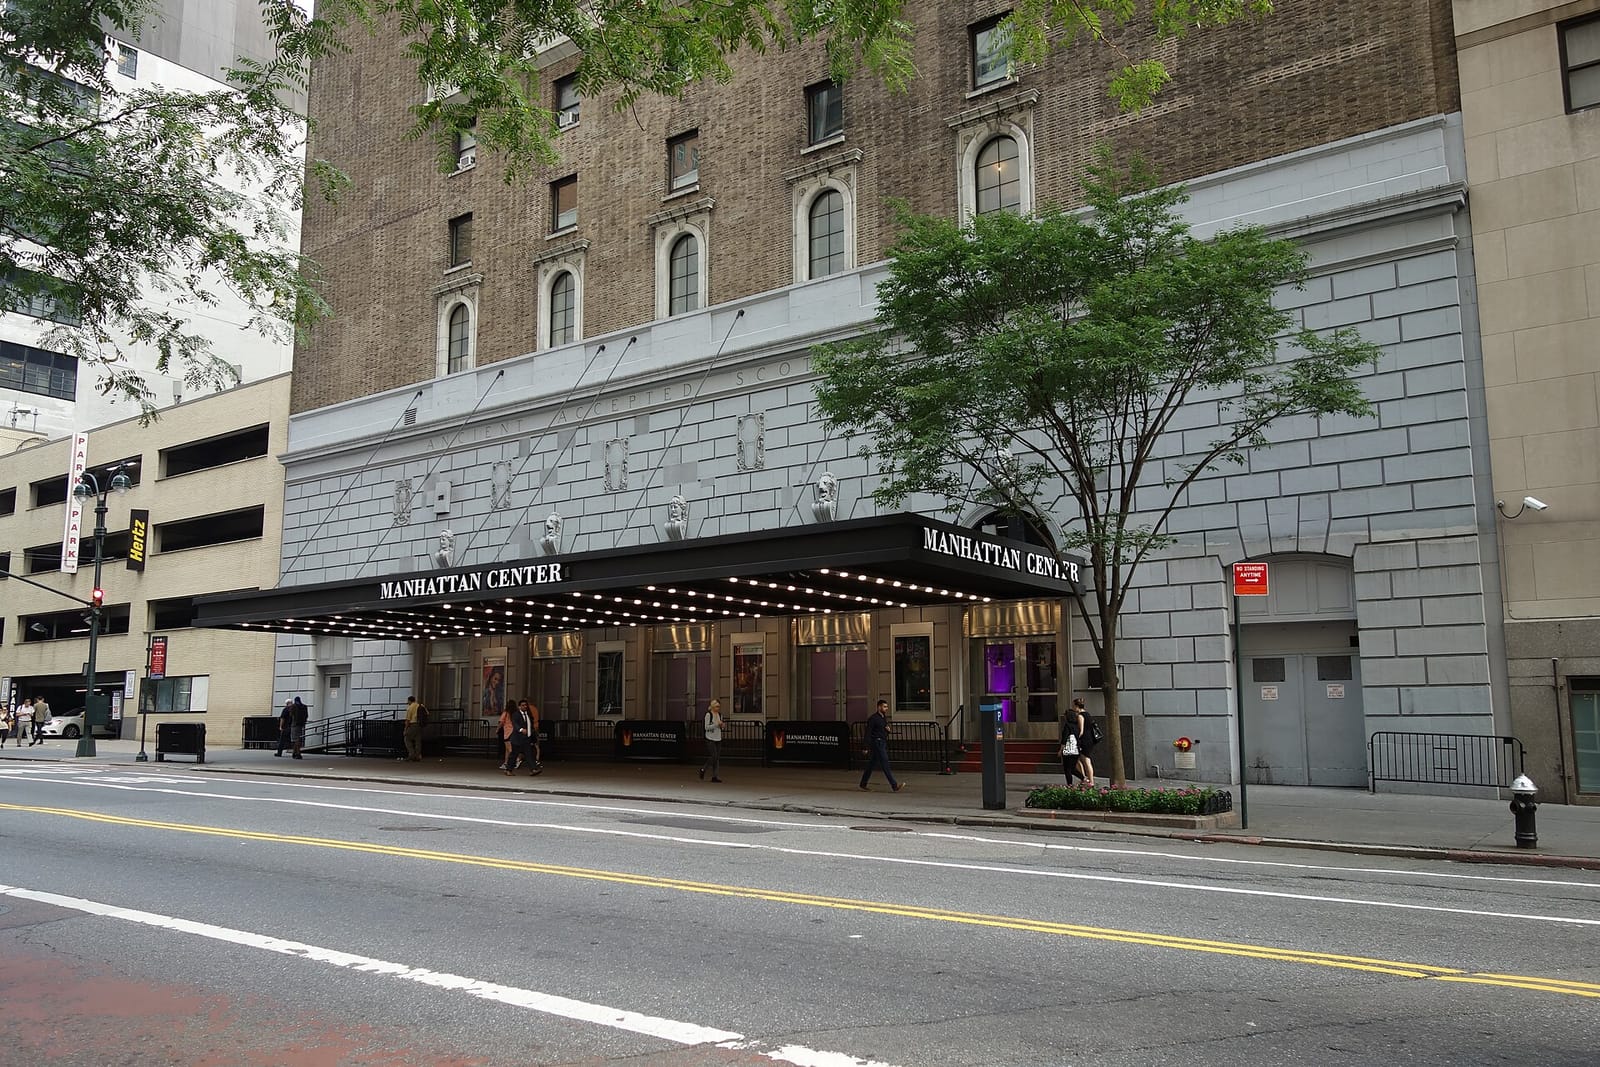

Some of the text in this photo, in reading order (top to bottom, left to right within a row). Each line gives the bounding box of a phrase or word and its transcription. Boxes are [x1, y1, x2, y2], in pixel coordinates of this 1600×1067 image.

[425, 419, 524, 450] ANCIENT
[557, 383, 692, 423] ACCEPTED
[68, 437, 85, 558] PARK PARK
[129, 519, 146, 562] Hertz
[923, 526, 1080, 583] MANHATTAN CENTER
[379, 563, 563, 600] MANHATTAN CENTER
